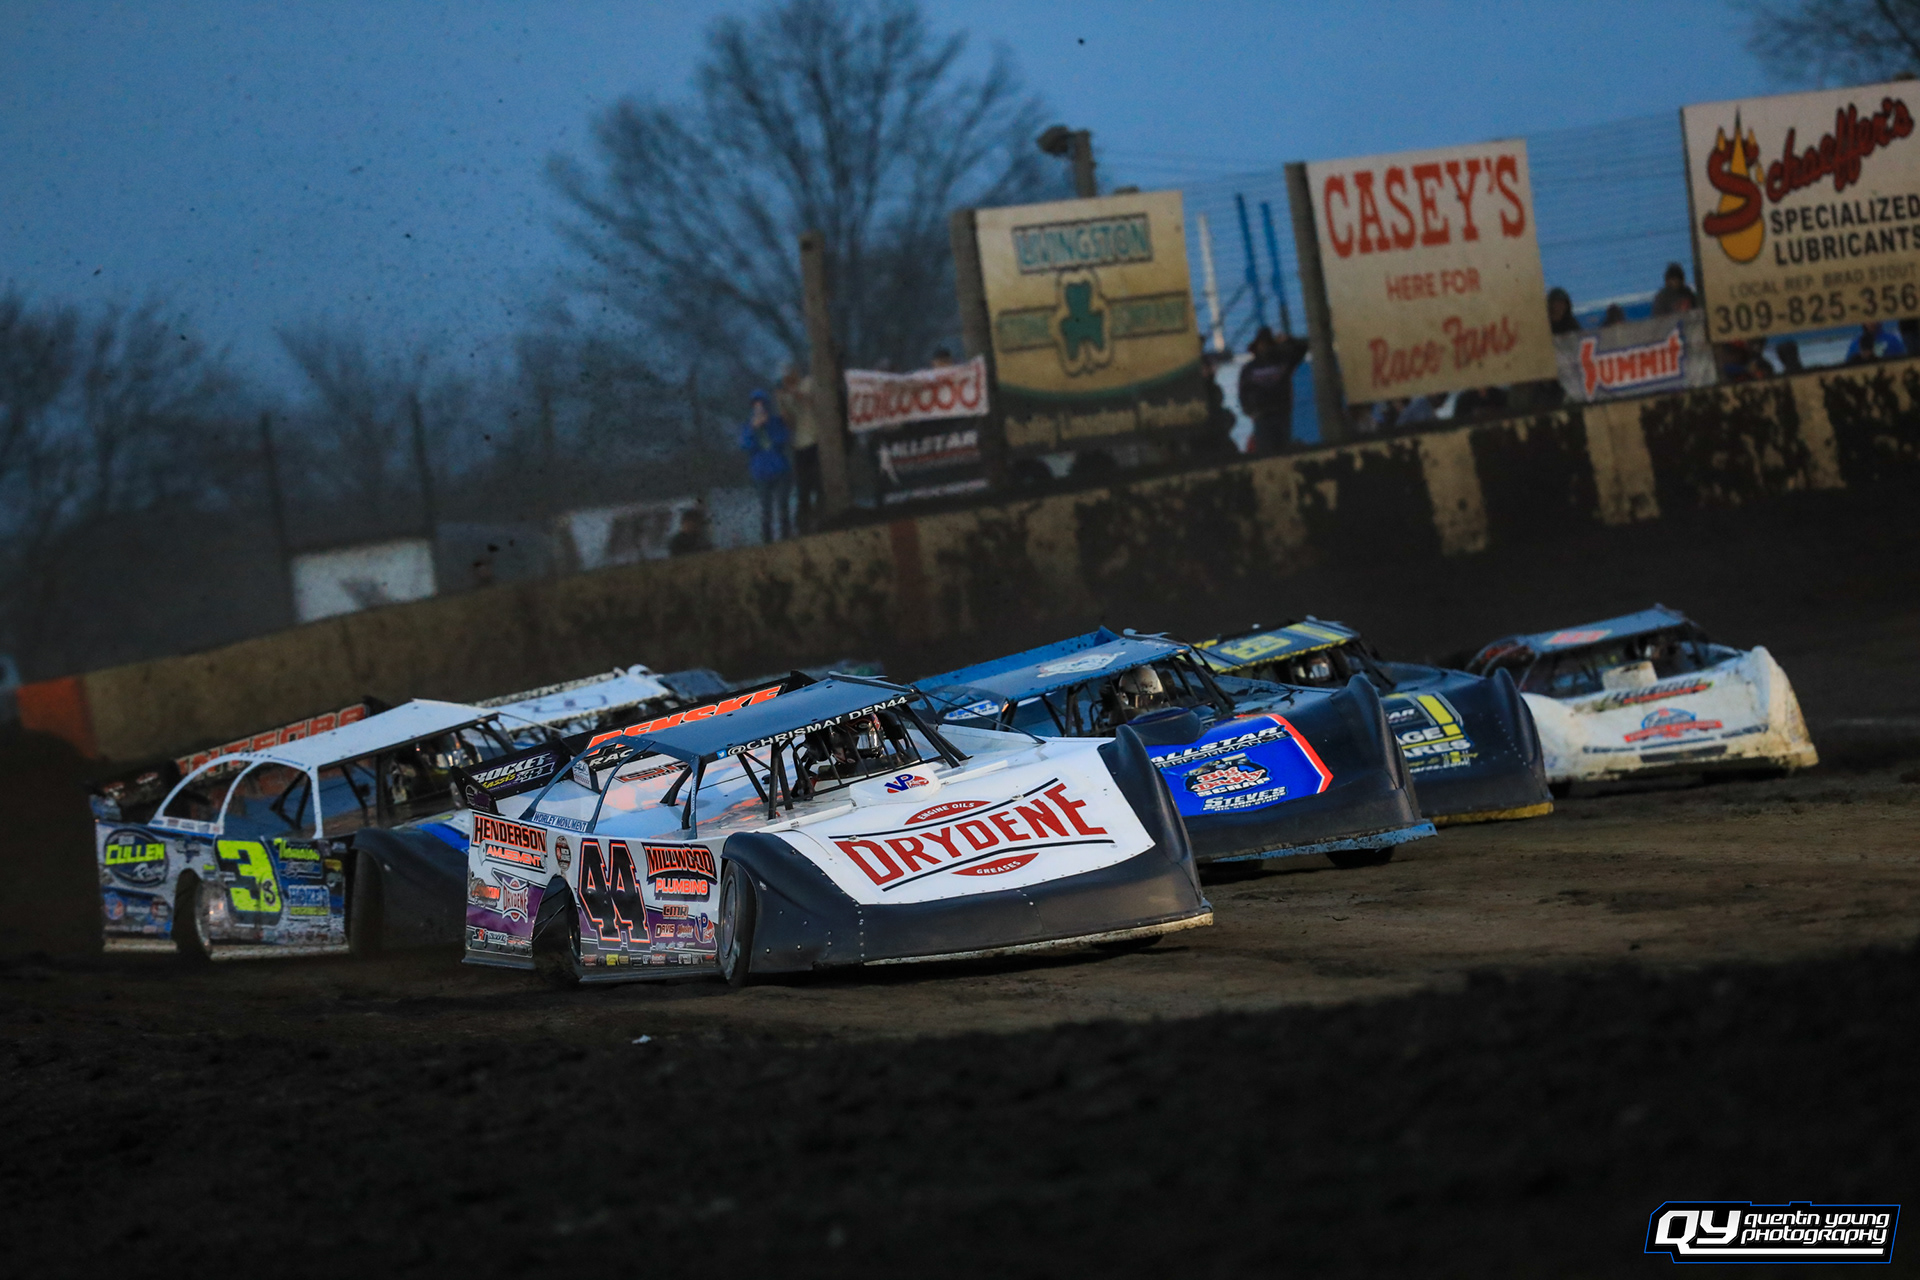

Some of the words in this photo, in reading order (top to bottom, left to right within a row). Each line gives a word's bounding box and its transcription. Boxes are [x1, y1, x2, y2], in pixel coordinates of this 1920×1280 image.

[1324, 155, 1526, 258] CASEY'S
[1770, 194, 1920, 235] SPECIALIZED
[1017, 221, 1150, 266] LIVINGSTON
[1774, 227, 1920, 266] LUBRICANTS
[1386, 273, 1437, 301] HERE
[1442, 267, 1480, 293] FOR
[1715, 283, 1920, 335] 309-825-356
[1368, 337, 1443, 388] Race
[1442, 315, 1518, 370] Fans
[1150, 726, 1279, 763] ALLSTAR
[472, 752, 551, 783] ROCKET
[884, 774, 913, 791] VP
[533, 812, 560, 826] WORLEY
[556, 817, 588, 832] MONUMENT
[917, 805, 949, 820] ENGINE
[473, 815, 547, 853] HENDERSON
[834, 782, 1108, 886] DRYDENE
[486, 846, 541, 866] AMUSEMENT
[644, 846, 717, 877] MILLWOOD
[976, 861, 1021, 874] GREASES
[579, 840, 651, 943] 44
[655, 878, 708, 895] PLUMBING
